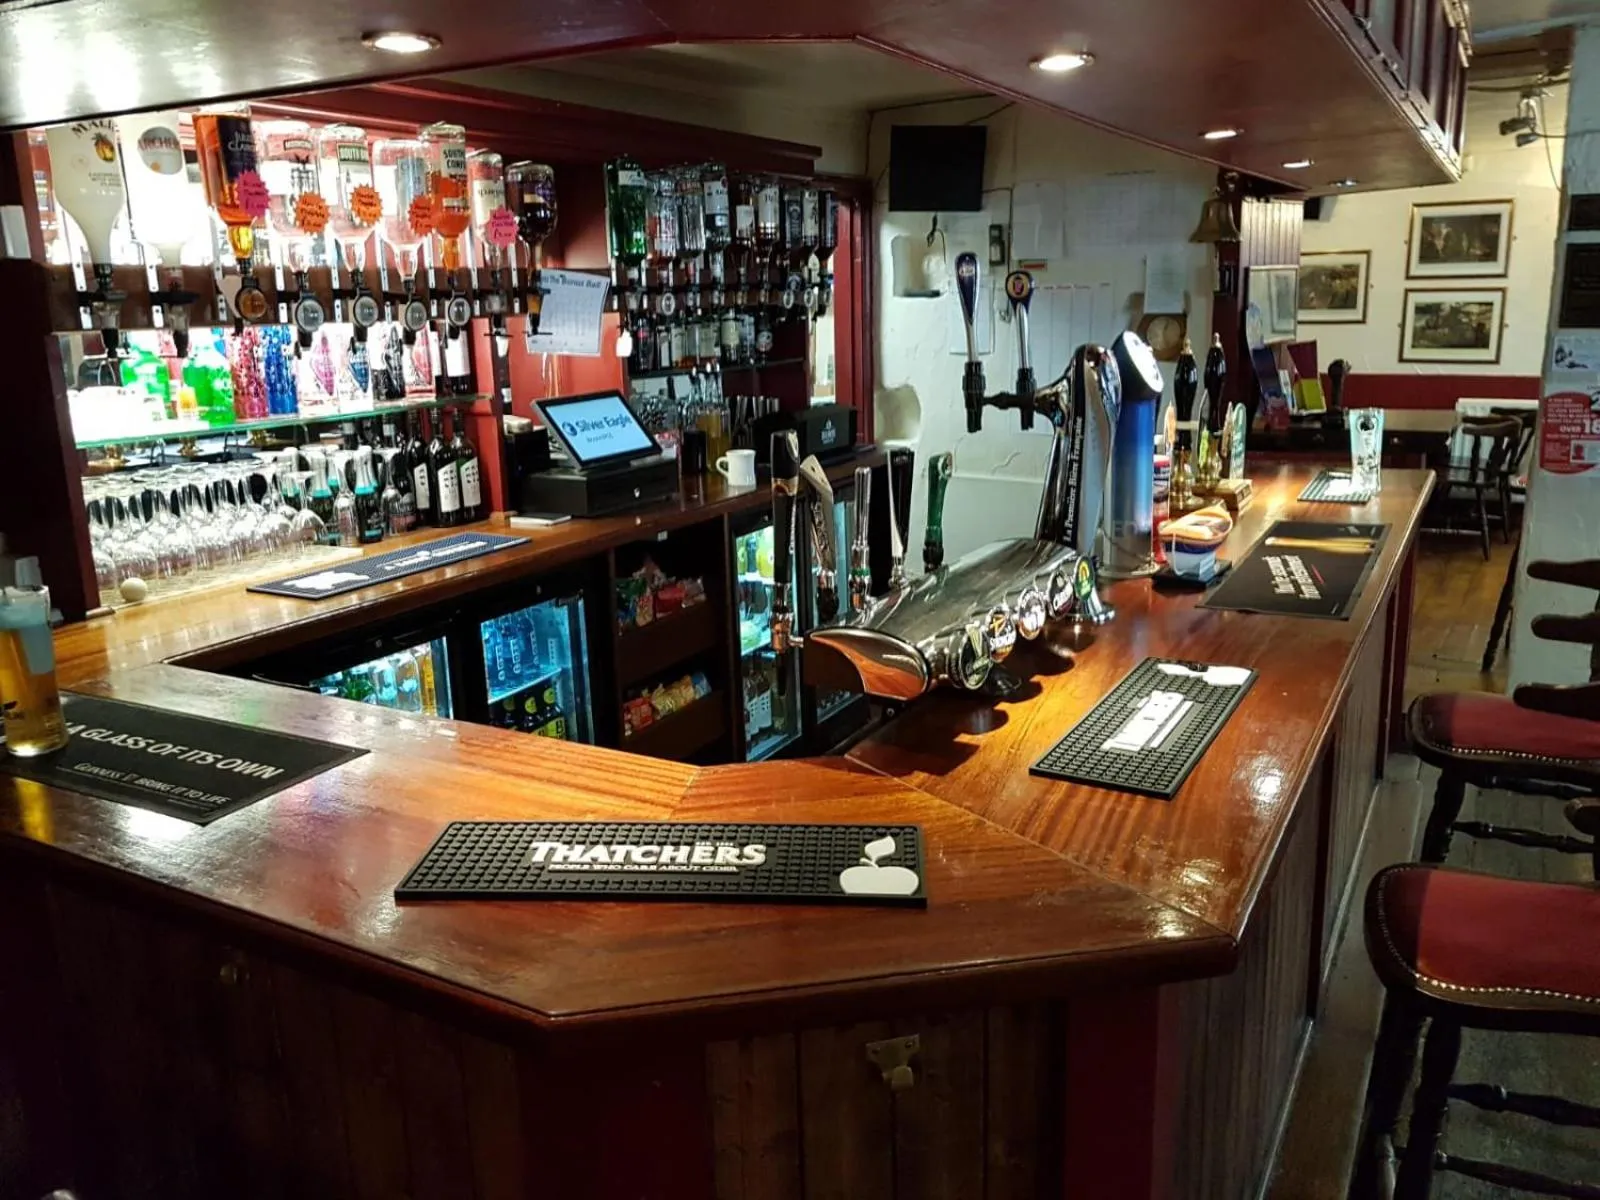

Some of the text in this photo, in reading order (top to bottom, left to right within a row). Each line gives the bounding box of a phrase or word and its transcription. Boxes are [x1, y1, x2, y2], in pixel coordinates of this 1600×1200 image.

[575, 413, 633, 433] Silver Eagle
[79, 727, 155, 750] GLASS
[146, 742, 189, 757] OF
[176, 748, 223, 765] ITS
[215, 757, 286, 780] OWN
[200, 793, 230, 804] LIFE
[528, 841, 767, 866] THATCHERS
